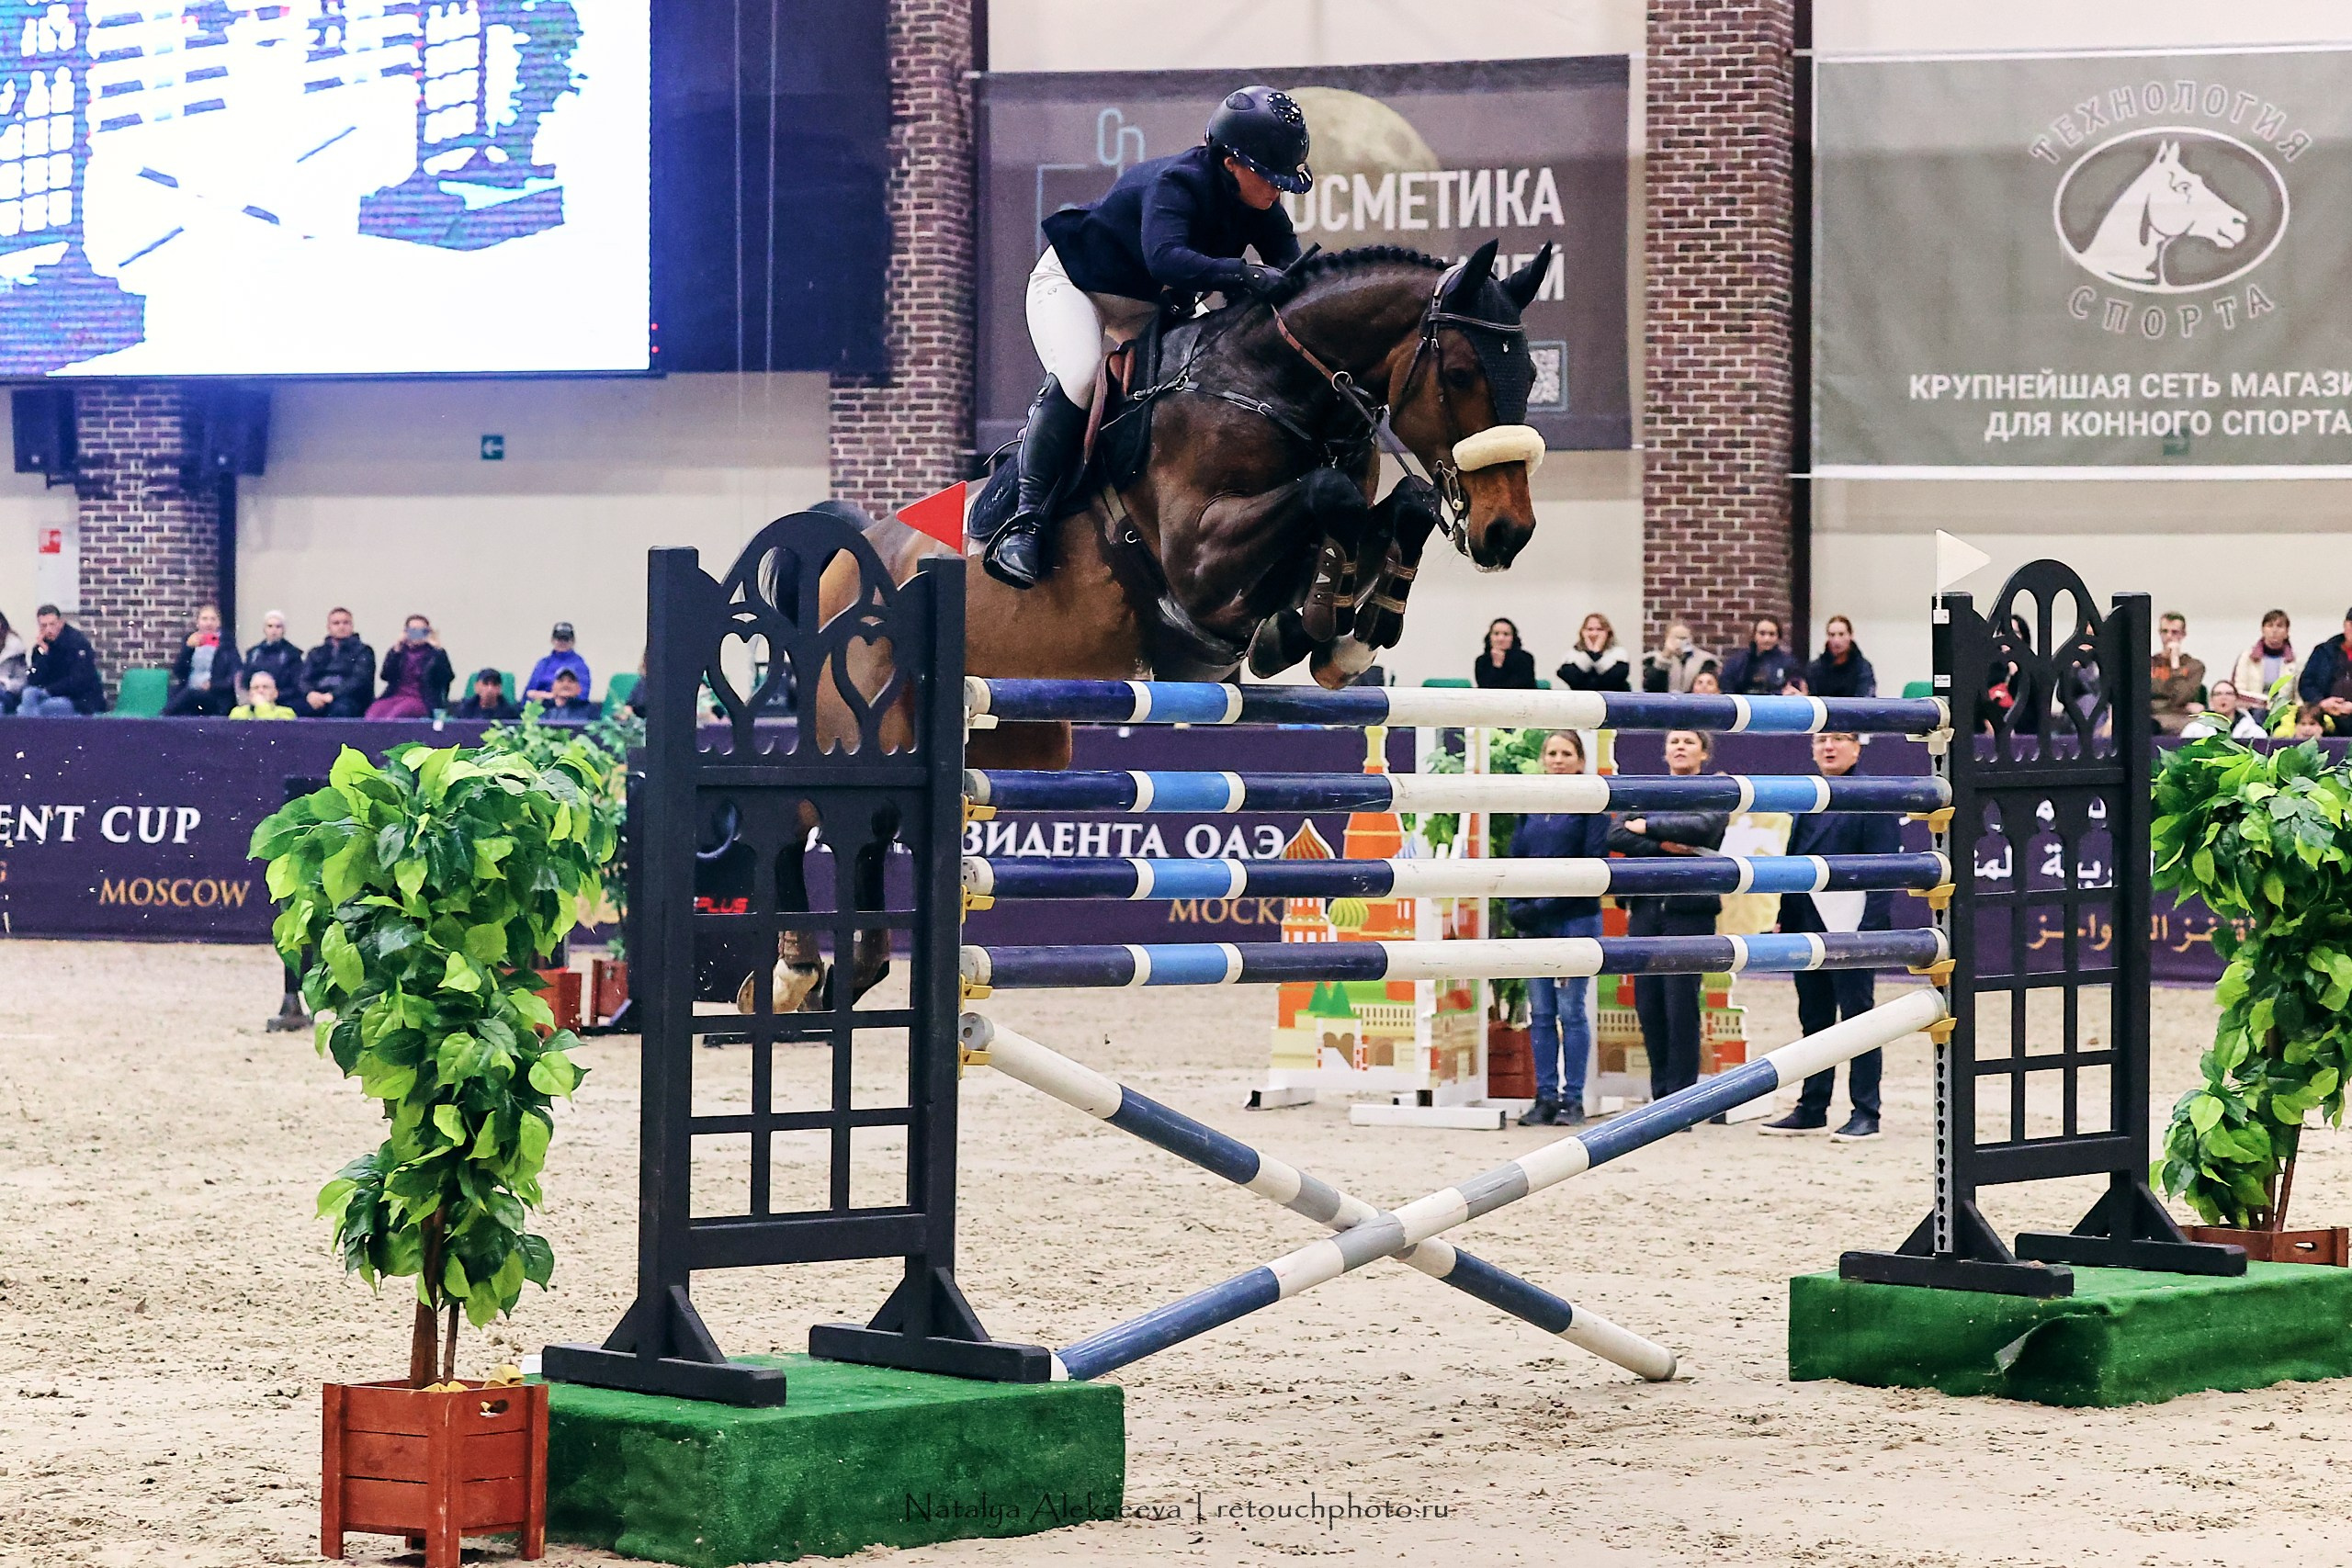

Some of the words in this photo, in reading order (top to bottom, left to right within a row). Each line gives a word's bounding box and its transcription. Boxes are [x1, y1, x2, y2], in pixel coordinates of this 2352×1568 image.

[2028, 80, 2313, 165] ТЕХНОЛОГИЯ
[2069, 284, 2275, 339] СПОРТА
[1910, 369, 2131, 400] КРУПНЕЙШАЯ
[2140, 374, 2222, 399] СЕТЬ
[1984, 412, 2052, 443] ДЛЯ
[2061, 411, 2212, 437] КОННОГО
[2222, 410, 2352, 435] СПОРТА
[101, 805, 201, 843] CUP
[1184, 824, 1286, 860] ОАЭ
[98, 877, 251, 907] MOSCOW
